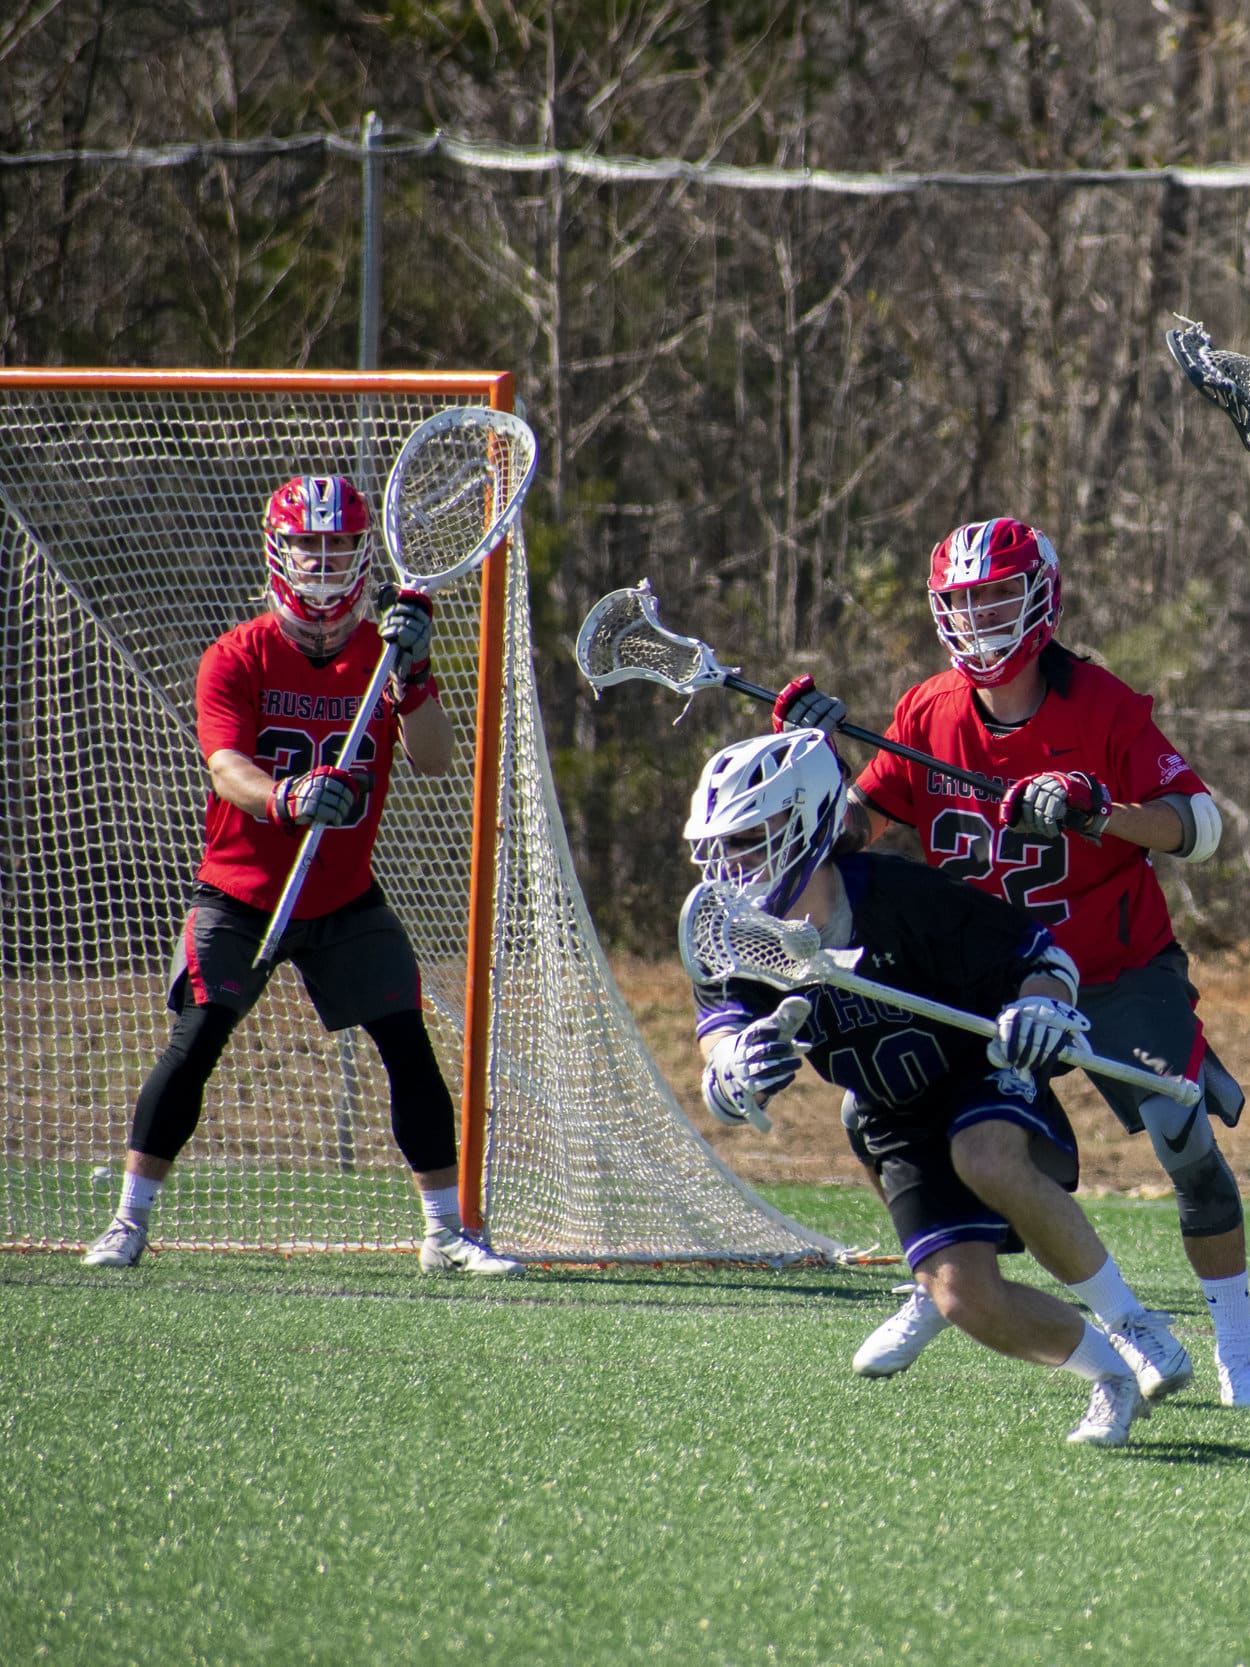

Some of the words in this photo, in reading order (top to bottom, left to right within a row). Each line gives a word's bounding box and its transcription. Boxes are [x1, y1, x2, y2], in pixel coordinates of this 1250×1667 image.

[259, 689, 386, 722] RUSADES
[930, 808, 1071, 928] 22
[829, 1026, 950, 1111] 10
